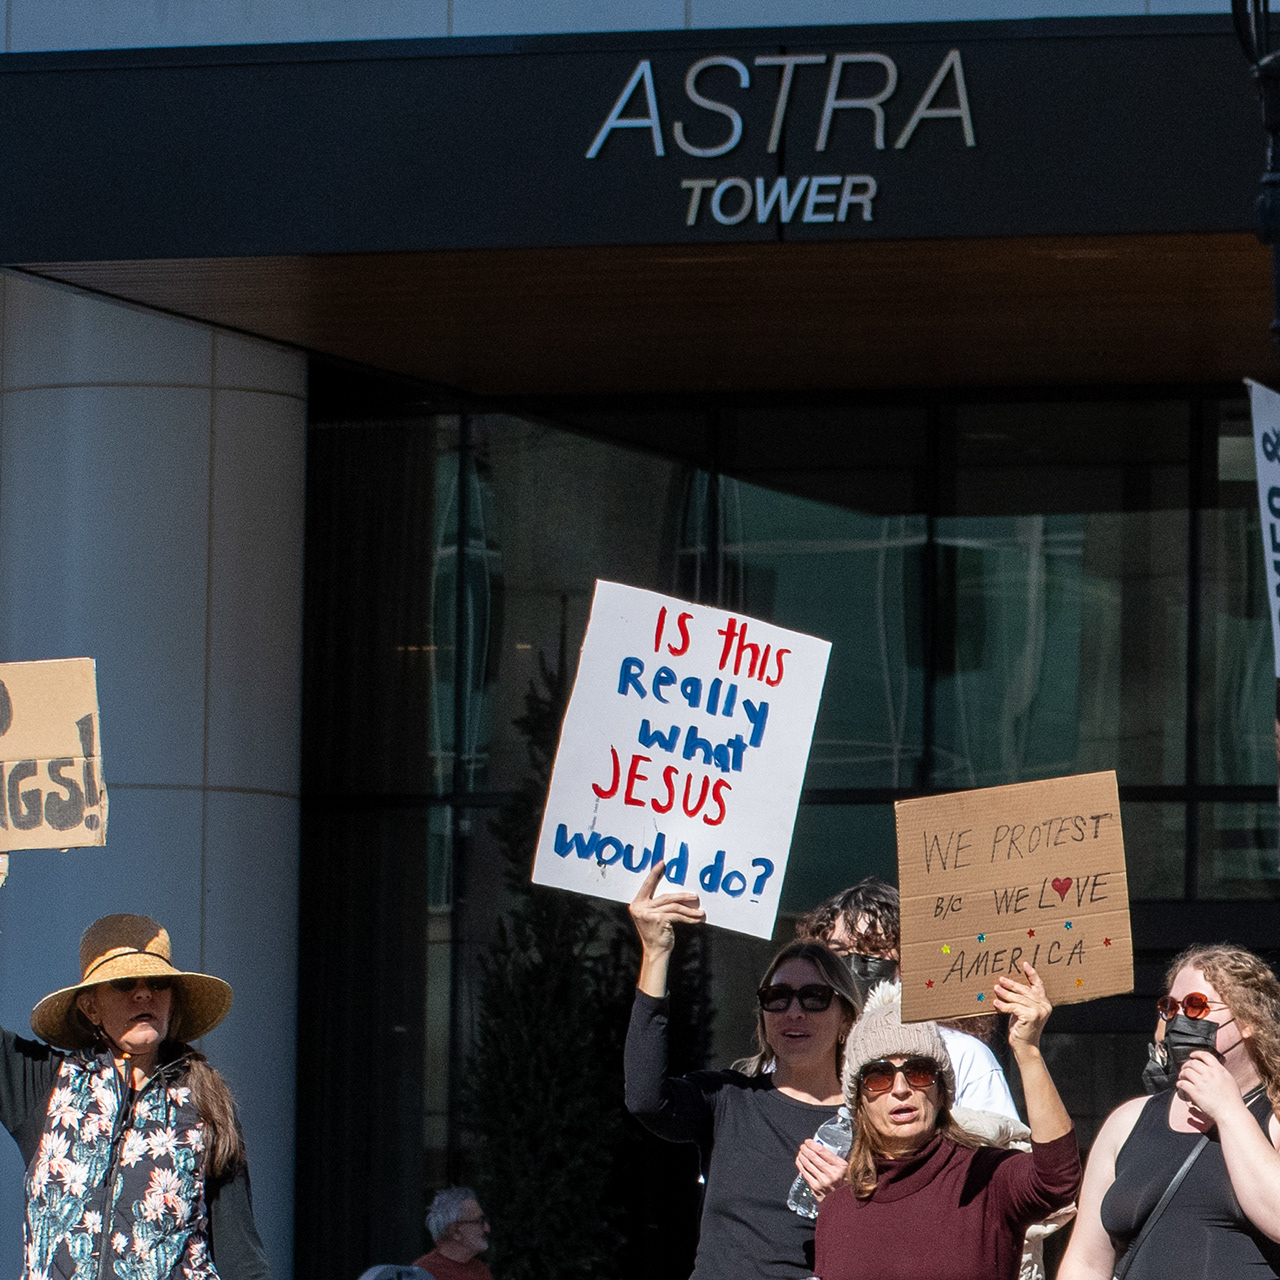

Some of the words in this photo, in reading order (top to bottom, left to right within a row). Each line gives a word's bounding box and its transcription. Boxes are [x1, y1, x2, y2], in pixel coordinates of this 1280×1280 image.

[585, 49, 976, 159] ASTRA
[681, 175, 877, 226] TOWER
[638, 719, 748, 772] what
[592, 744, 732, 826] JESUS
[923, 829, 972, 874] WE
[990, 812, 1113, 863] PROTEST
[700, 850, 774, 903] do?
[934, 895, 962, 920] B/C
[994, 887, 1029, 915] WE
[942, 940, 1086, 984] AMERICA
